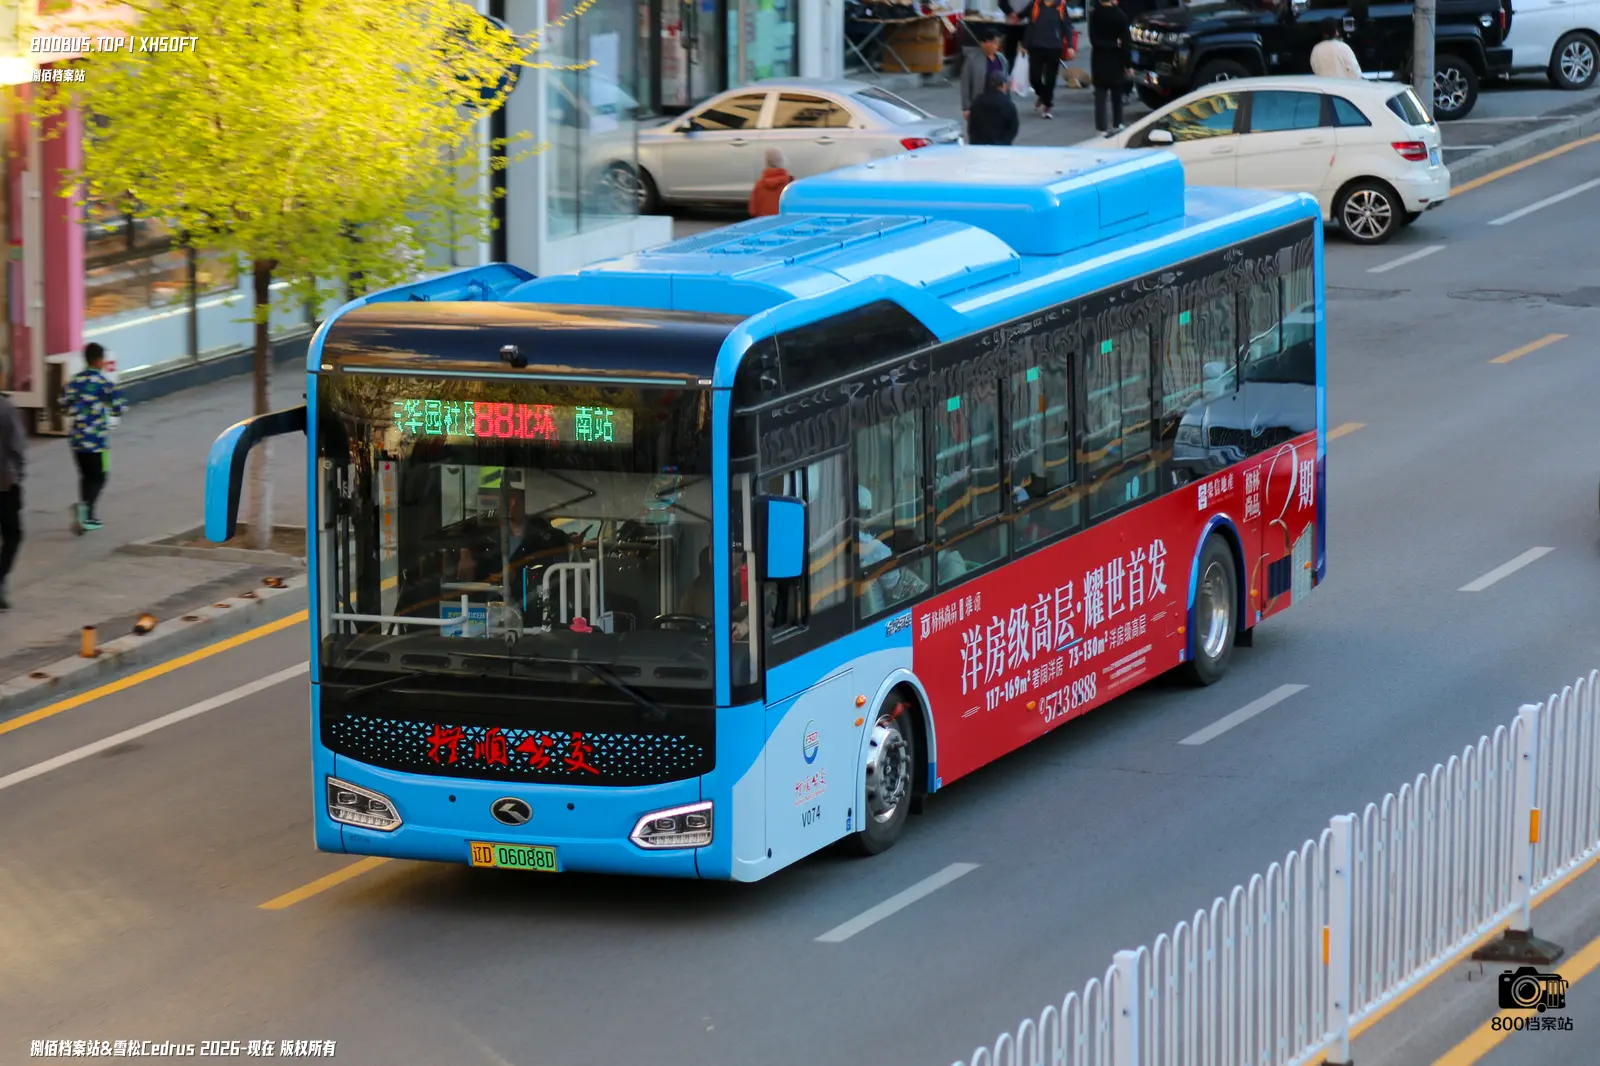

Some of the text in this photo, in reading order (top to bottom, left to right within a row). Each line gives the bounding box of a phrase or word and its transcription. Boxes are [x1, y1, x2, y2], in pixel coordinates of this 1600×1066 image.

[575, 405, 614, 442] 南站
[802, 805, 821, 828] V074
[473, 845, 555, 869] 辽D 06088D
